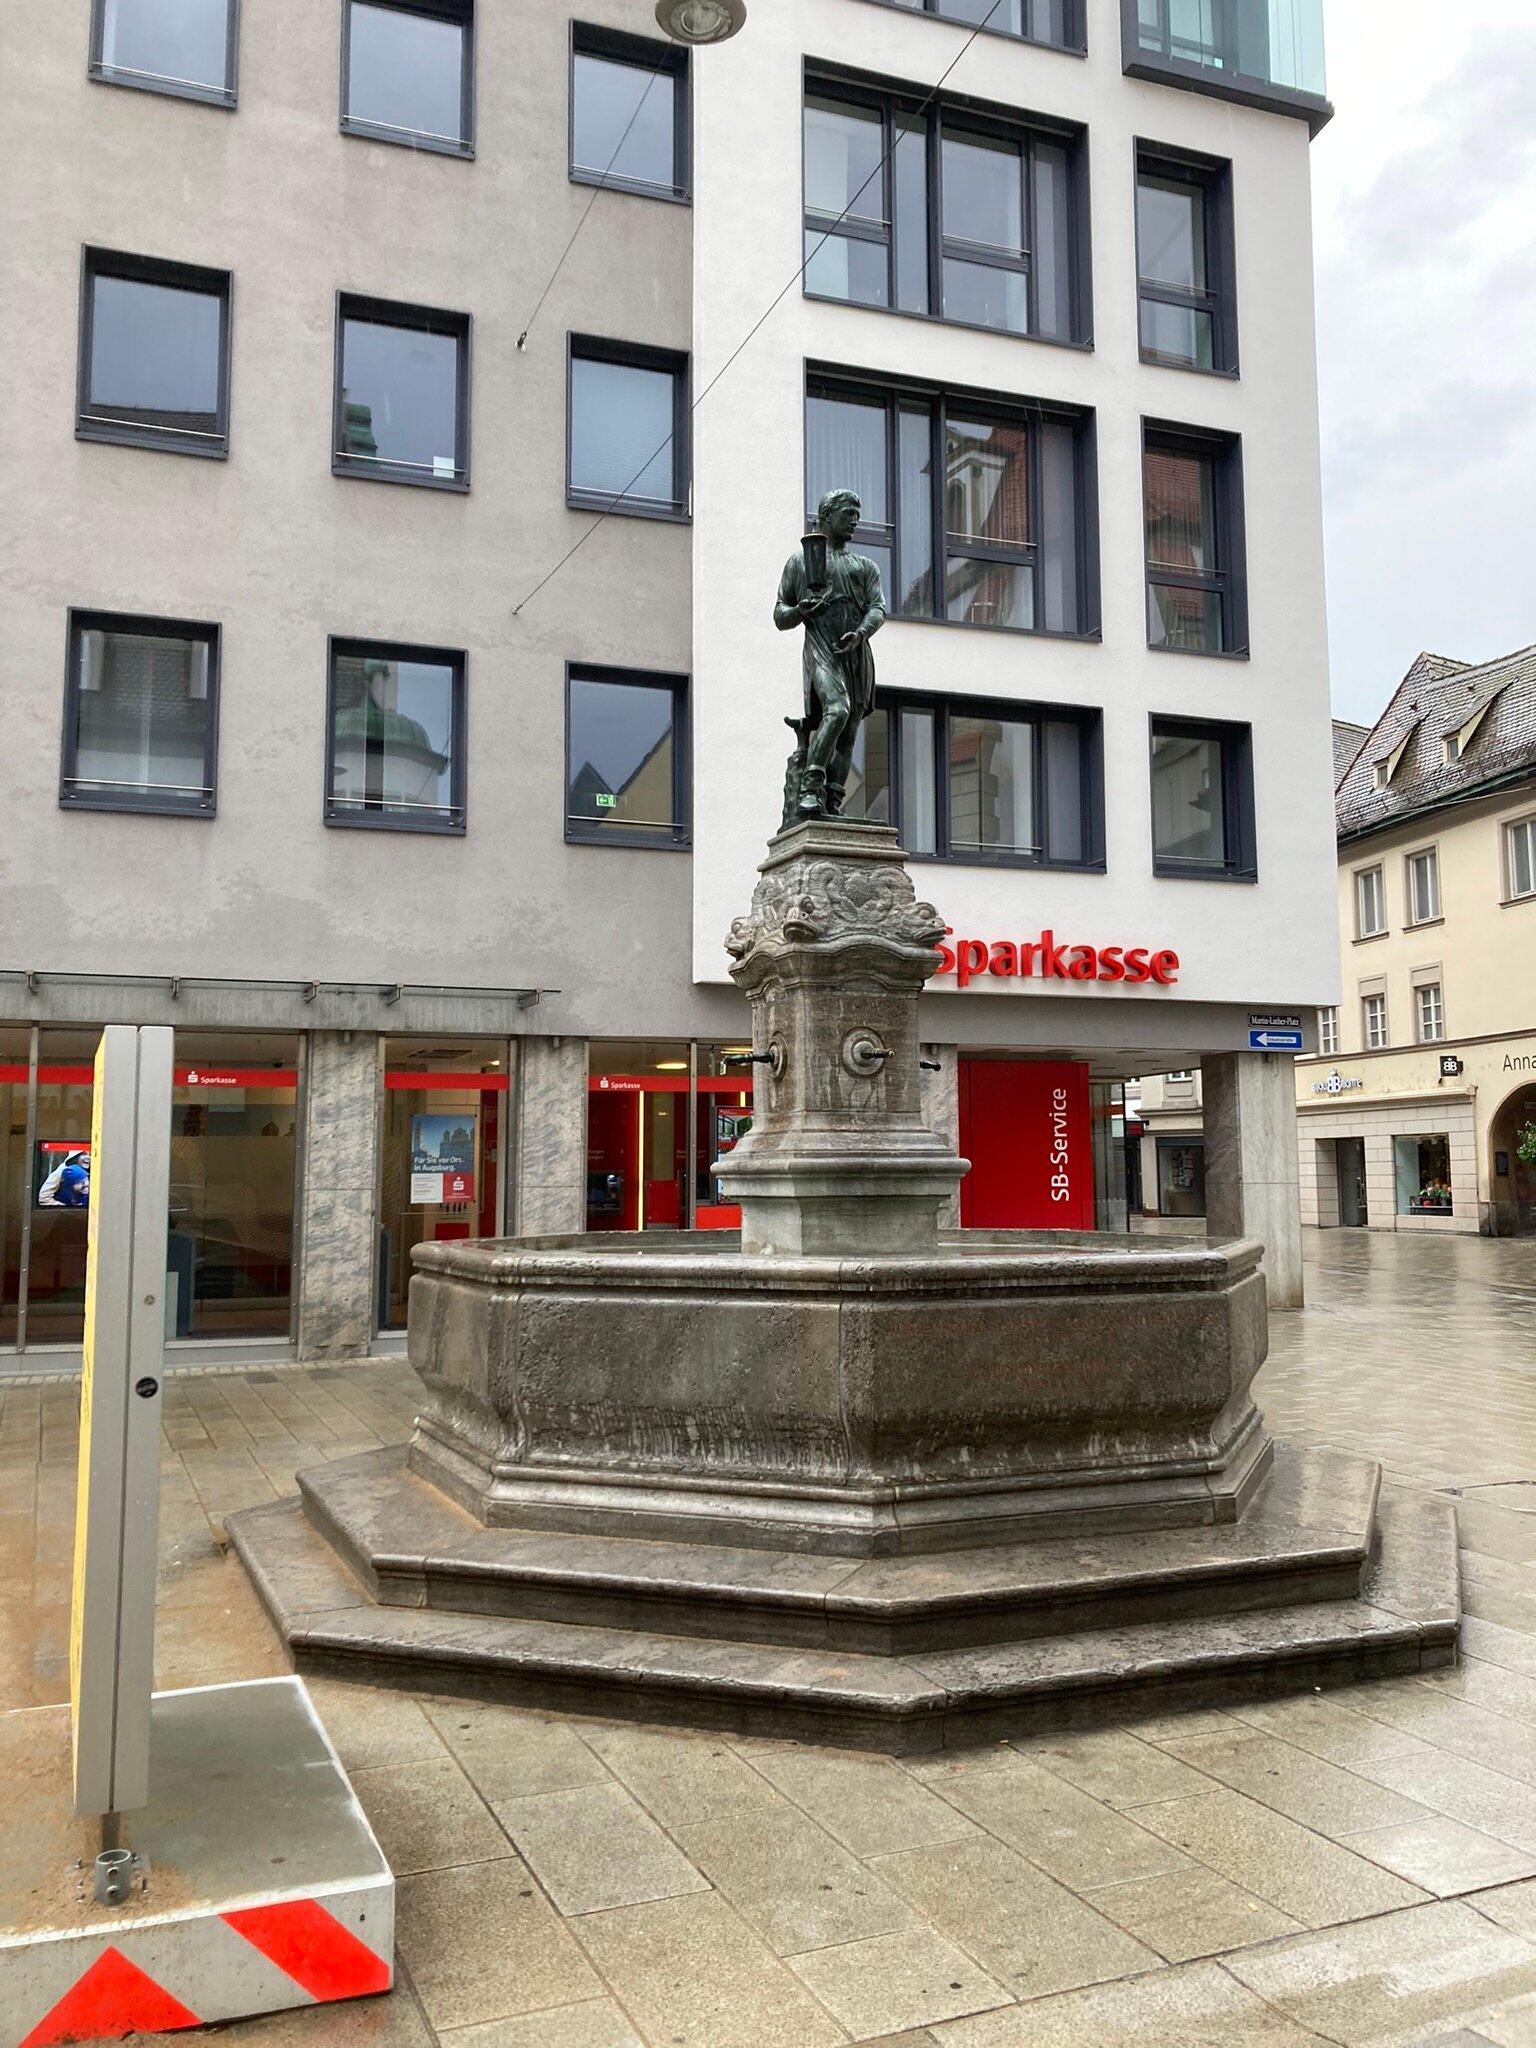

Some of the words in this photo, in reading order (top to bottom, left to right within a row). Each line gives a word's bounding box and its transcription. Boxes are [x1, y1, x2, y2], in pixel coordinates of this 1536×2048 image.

[200, 1076, 237, 1085] Sparkasse
[610, 1081, 641, 1090] Sparkasse
[1050, 1088, 1070, 1202] SB-Service
